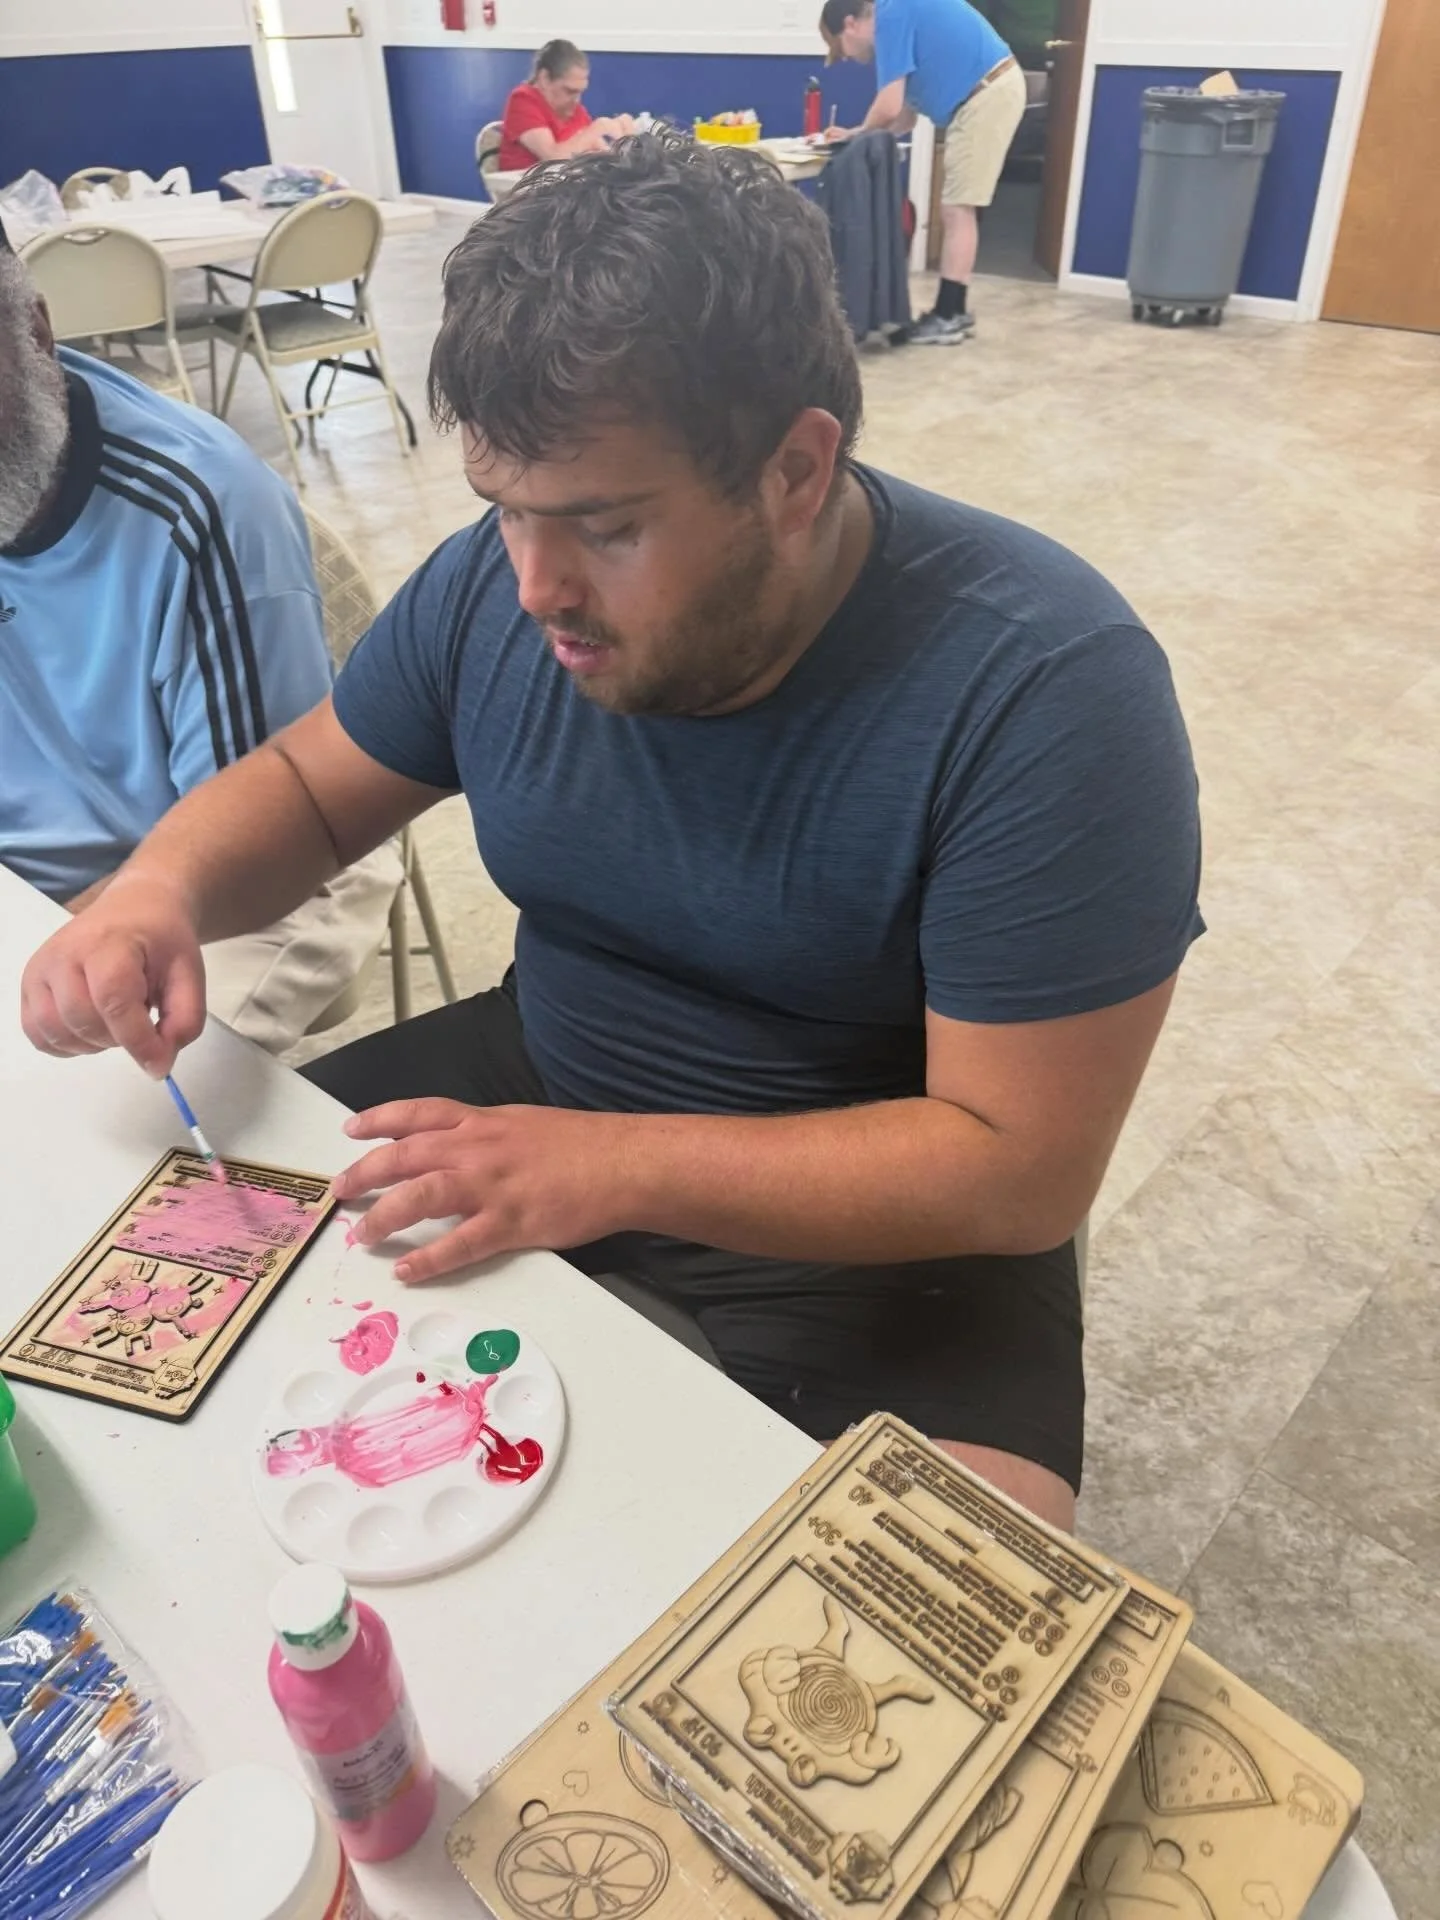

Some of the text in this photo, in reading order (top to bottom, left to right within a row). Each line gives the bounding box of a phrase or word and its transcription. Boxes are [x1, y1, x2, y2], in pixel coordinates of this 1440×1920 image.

[847, 1485, 875, 1507] 40
[807, 1516, 842, 1546] 30+
[679, 1716, 723, 1758] 90 HP
